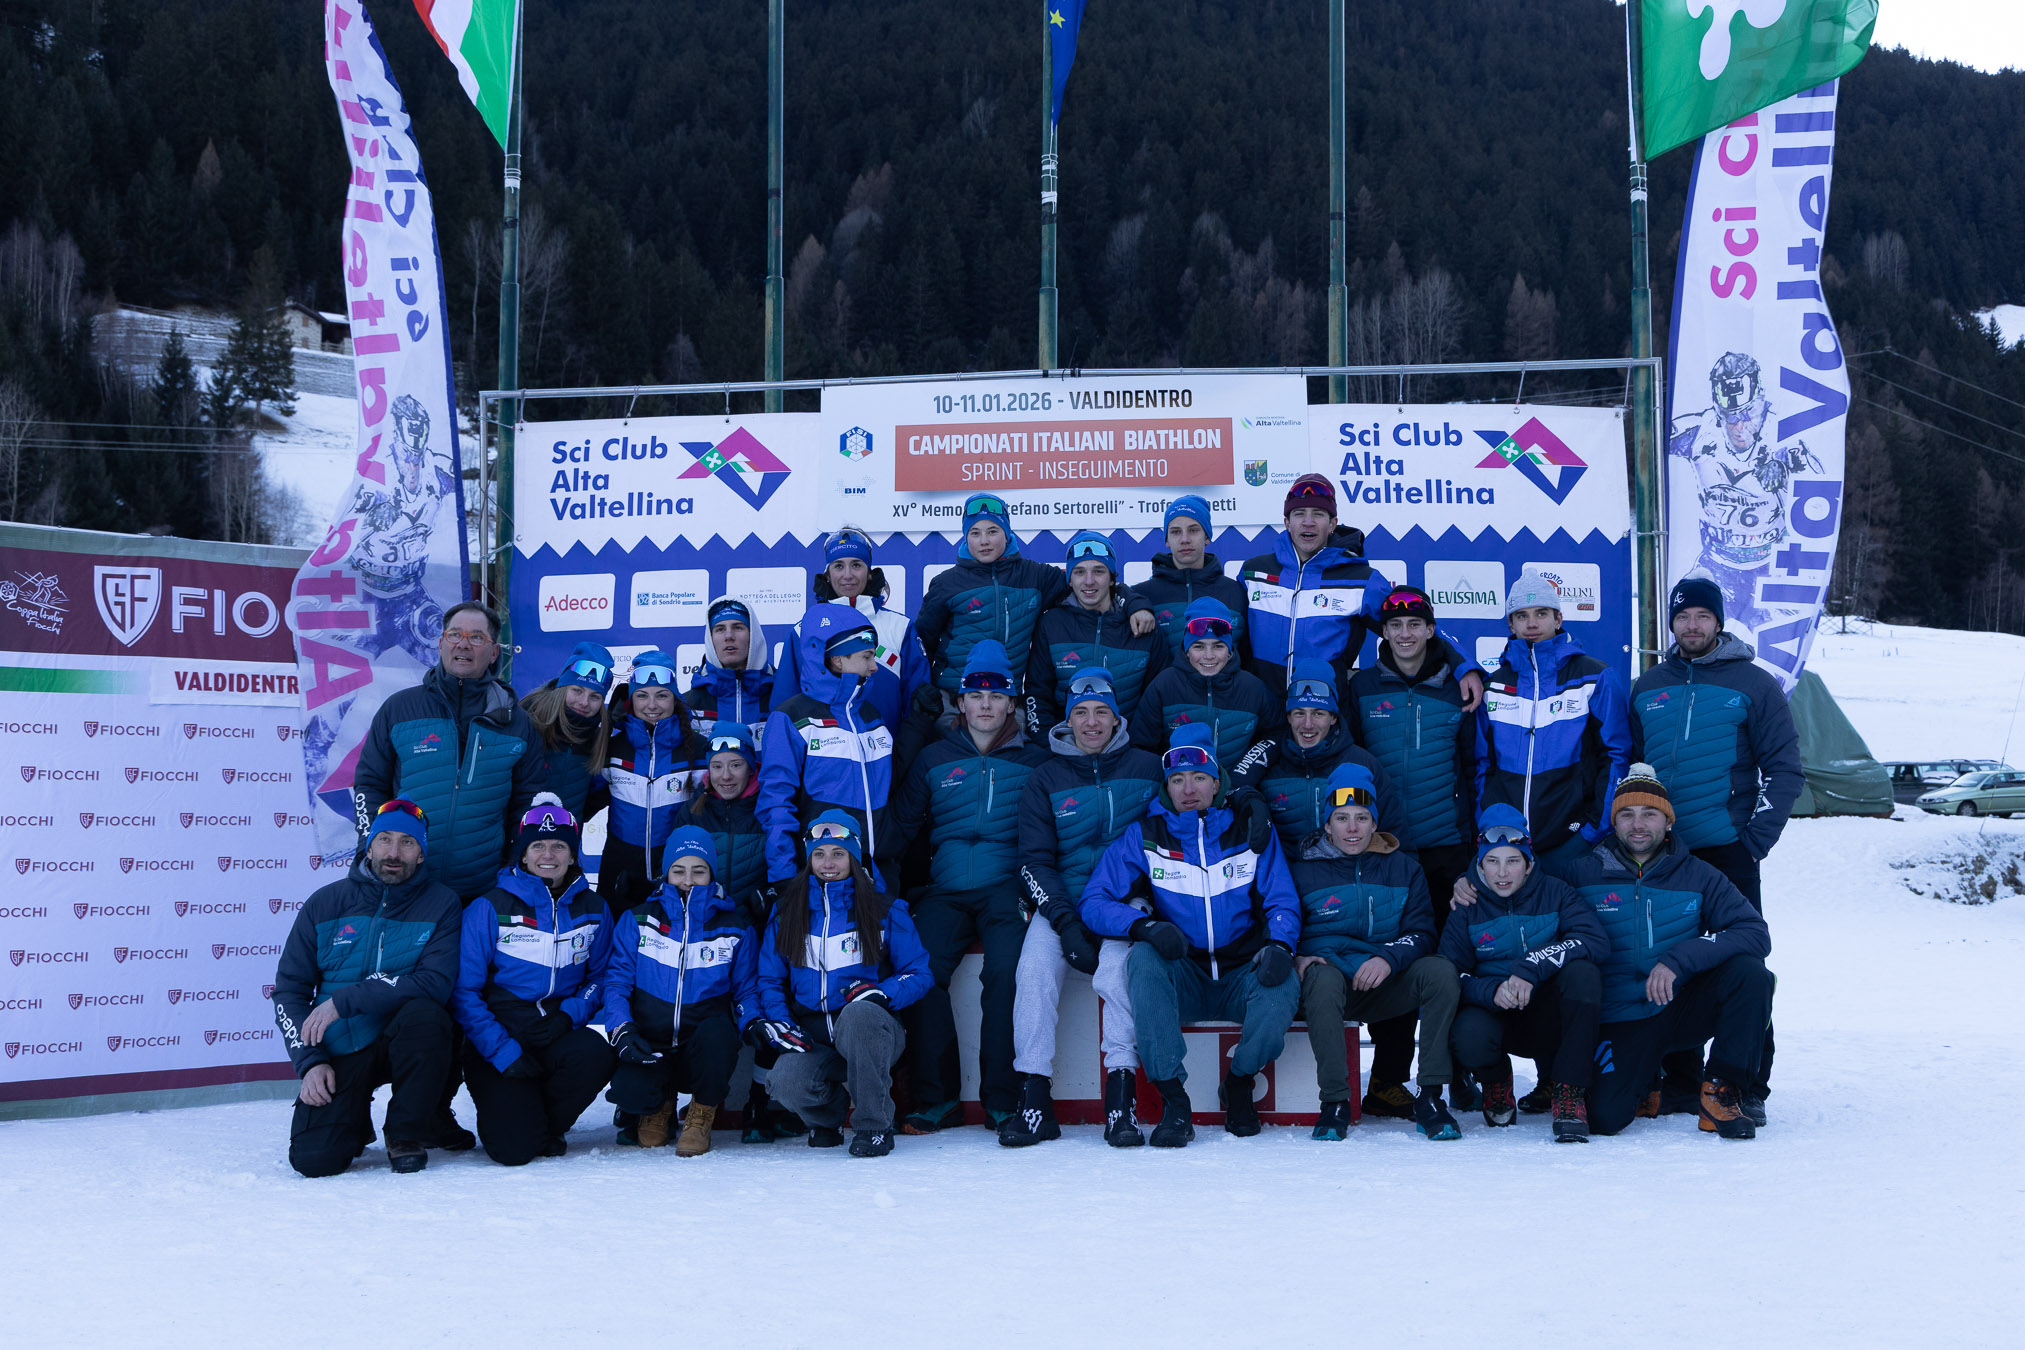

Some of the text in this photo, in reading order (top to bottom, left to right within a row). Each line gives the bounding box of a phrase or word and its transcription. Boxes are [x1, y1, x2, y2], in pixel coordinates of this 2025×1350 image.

[1711, 205, 1758, 301] Sci
[933, 392, 1052, 414] 10-11.01.2026
[1070, 389, 1193, 411] VALDIDENTRO
[1273, 419, 1301, 427] Valtellina
[846, 428, 868, 437] FISI
[1339, 422, 1463, 446] Sci Club
[909, 428, 1222, 455] CAMPIONATI ITALIANI BIATHLON
[552, 436, 668, 464] Sci Club
[1340, 451, 1405, 476] Alta
[962, 462, 1023, 482] SPRINT
[1040, 458, 1168, 480] INSEGUIMENTO
[550, 469, 609, 493] Alta
[1340, 479, 1495, 504] Valtellina
[550, 491, 694, 520] Valtellina
[922, 504, 963, 518] Memo
[1005, 501, 1050, 516] tefano
[1209, 497, 1237, 512] etti
[1718, 504, 1760, 528] 76
[829, 543, 858, 554] ESERCITO
[1540, 572, 1564, 585] ERCATO
[1757, 479, 1843, 676] Alta
[670, 591, 696, 600] Popolare
[1431, 589, 1497, 606] LEVISSIMA
[544, 594, 608, 613] Adecco
[613, 655, 632, 663] FICIO
[682, 665, 699, 675] ve
[175, 671, 299, 694] VALDIDENTR
[100, 724, 160, 736] FIOCCHI
[199, 726, 255, 739] FIOCCHI
[38, 769, 100, 781] FIOCCHI
[141, 770, 199, 782] FIOCCHI
[237, 771, 292, 783] FIOCCHI
[1, 815, 53, 827] IOCCHI
[96, 815, 156, 827] FIOCCHI
[195, 815, 252, 826] FIOCCHI
[32, 861, 95, 872] FIOCCHI
[135, 860, 194, 872] FIOCCHI
[233, 859, 288, 870] FIOCCHI
[0, 907, 47, 918] OCCHI
[90, 905, 151, 917] FIOCCHI
[190, 903, 247, 915] FIOCCHI
[130, 949, 189, 961] FIOCCHI
[227, 945, 282, 957] FIOCCHI
[27, 952, 89, 964] FIOCCHI
[84, 994, 144, 1007] FIOCCHI
[183, 990, 240, 1002] FIOCCHI
[276, 1004, 304, 1050] Adecco
[123, 1036, 181, 1048] FIOCCHI
[219, 1030, 274, 1042] FIOCCHI
[21, 1042, 83, 1055] FIOCCHI
